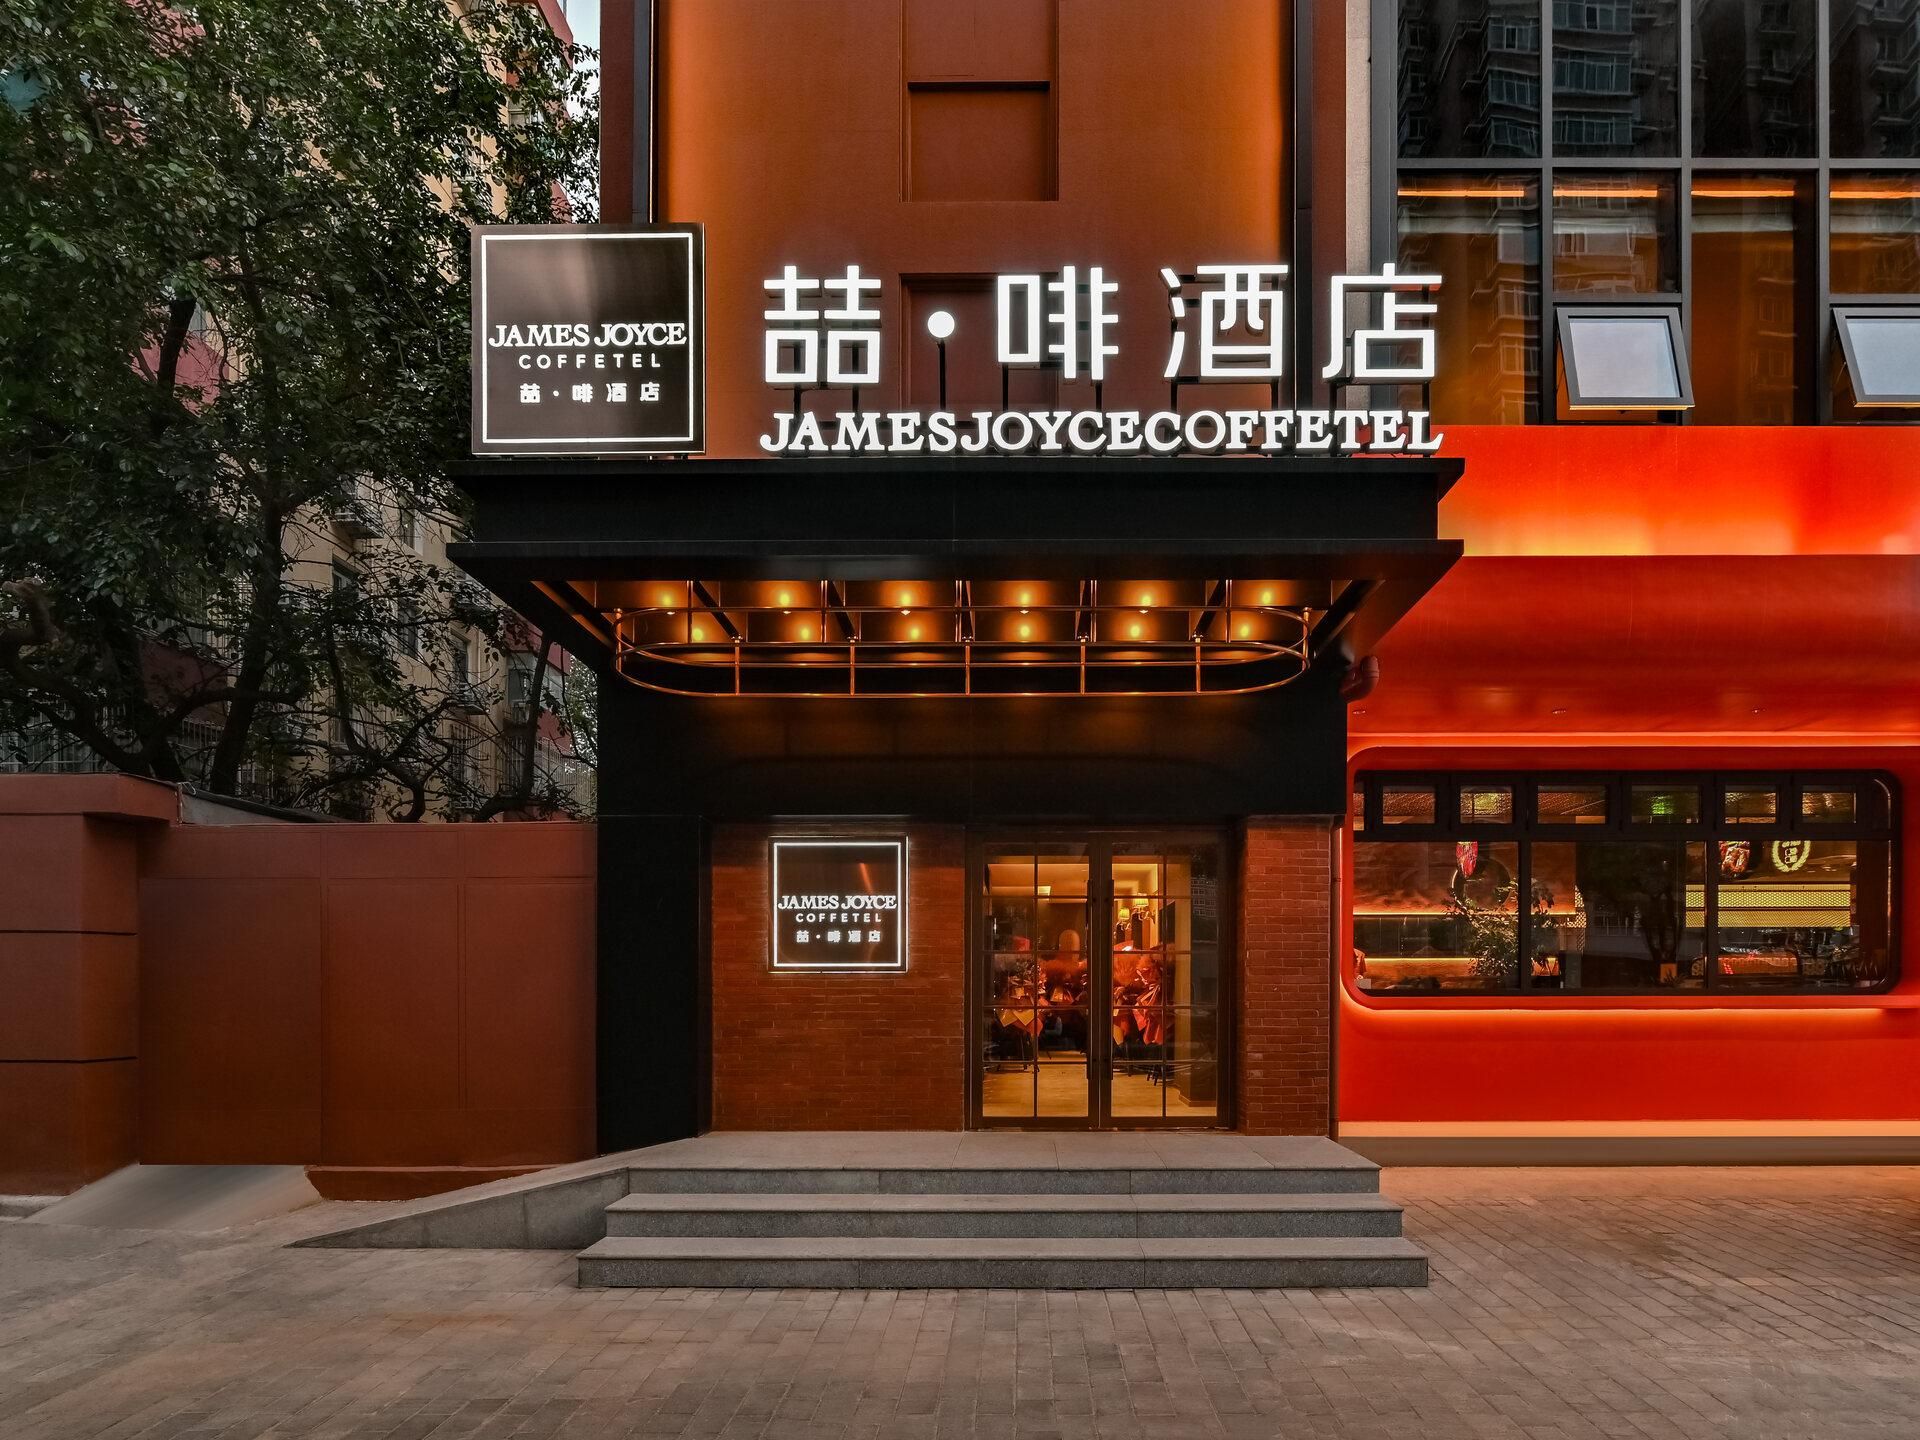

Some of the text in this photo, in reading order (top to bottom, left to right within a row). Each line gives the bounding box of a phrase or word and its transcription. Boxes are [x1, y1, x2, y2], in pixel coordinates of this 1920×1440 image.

[488, 322, 688, 347] JAMES JOYCE
[518, 353, 661, 370] COFFETEL
[777, 895, 898, 910] JAMES JOYCE
[795, 913, 882, 923] COFFETEL
